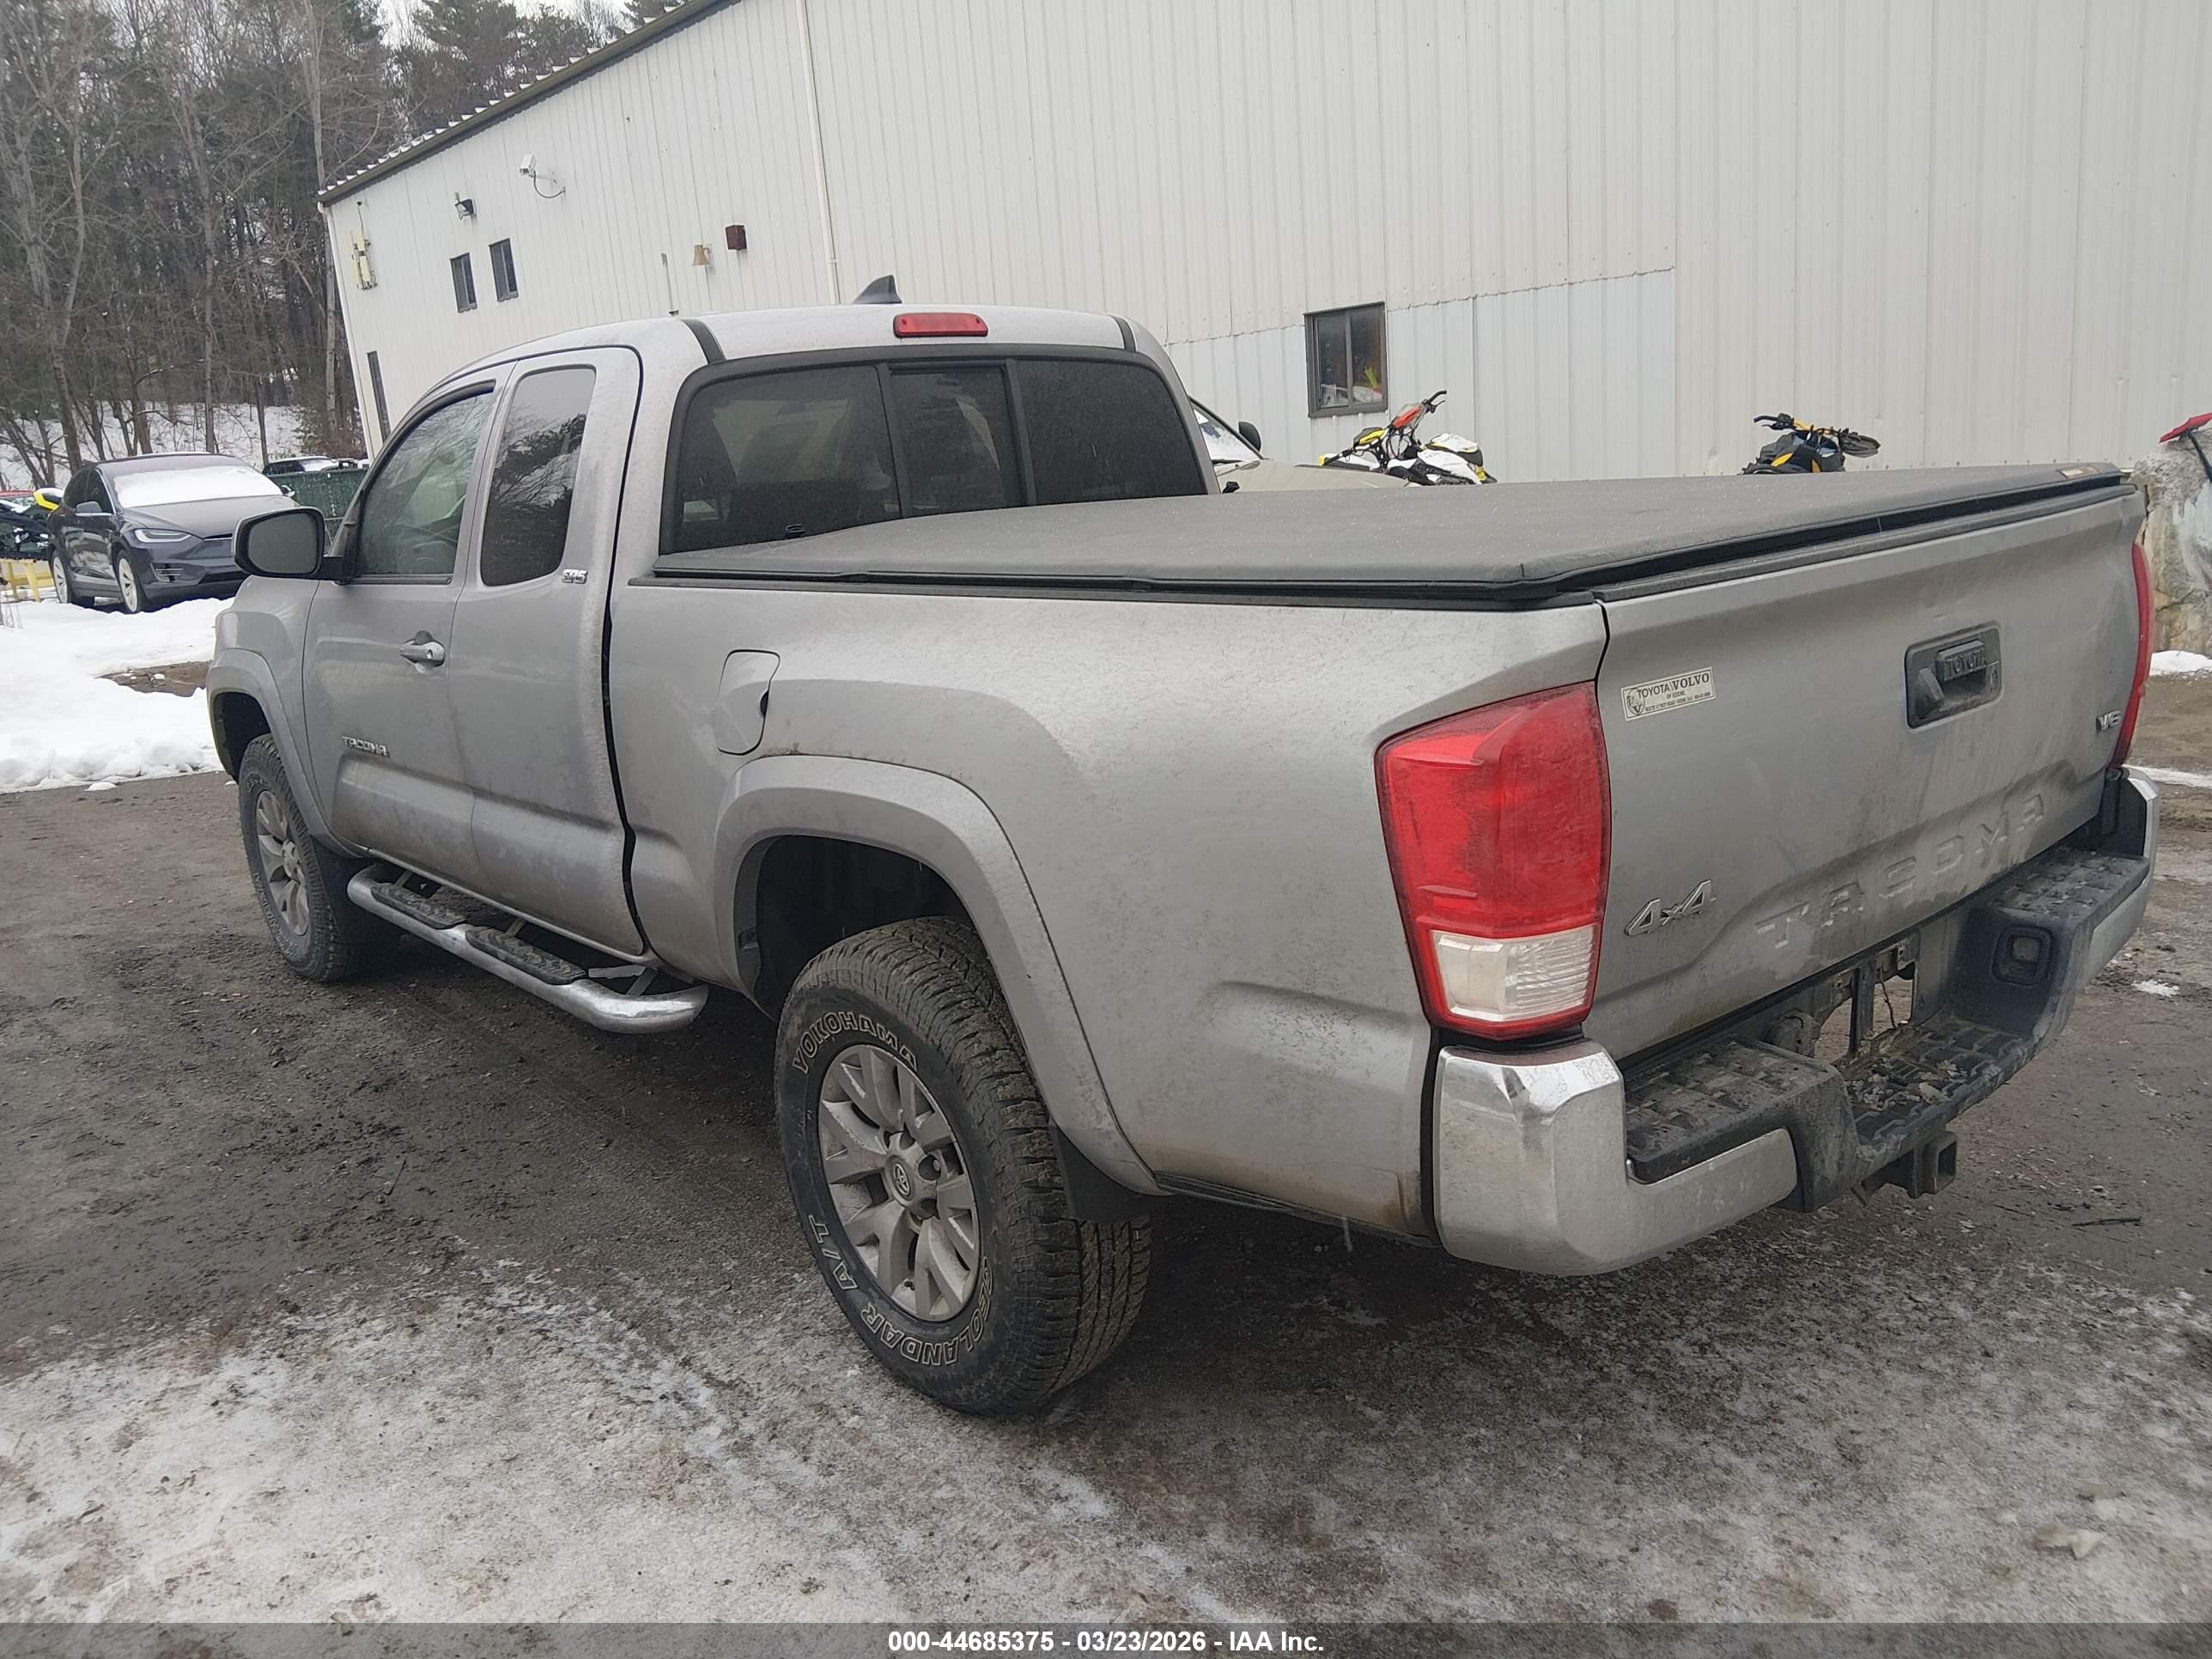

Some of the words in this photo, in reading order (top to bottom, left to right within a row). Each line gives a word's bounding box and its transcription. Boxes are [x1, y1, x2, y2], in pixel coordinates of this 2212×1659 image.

[562, 568, 588, 584] SR5
[1637, 684, 1670, 699] TOYOTA
[1672, 672, 1710, 690] VOLVO
[2096, 710, 2120, 731] V6
[341, 736, 389, 757] TACOMA
[1754, 793, 2045, 948] TACOMA
[793, 1011, 918, 1073] YOKOHAMA
[808, 1214, 859, 1290] A/T
[860, 1256, 994, 1366] GEOLANDAR
